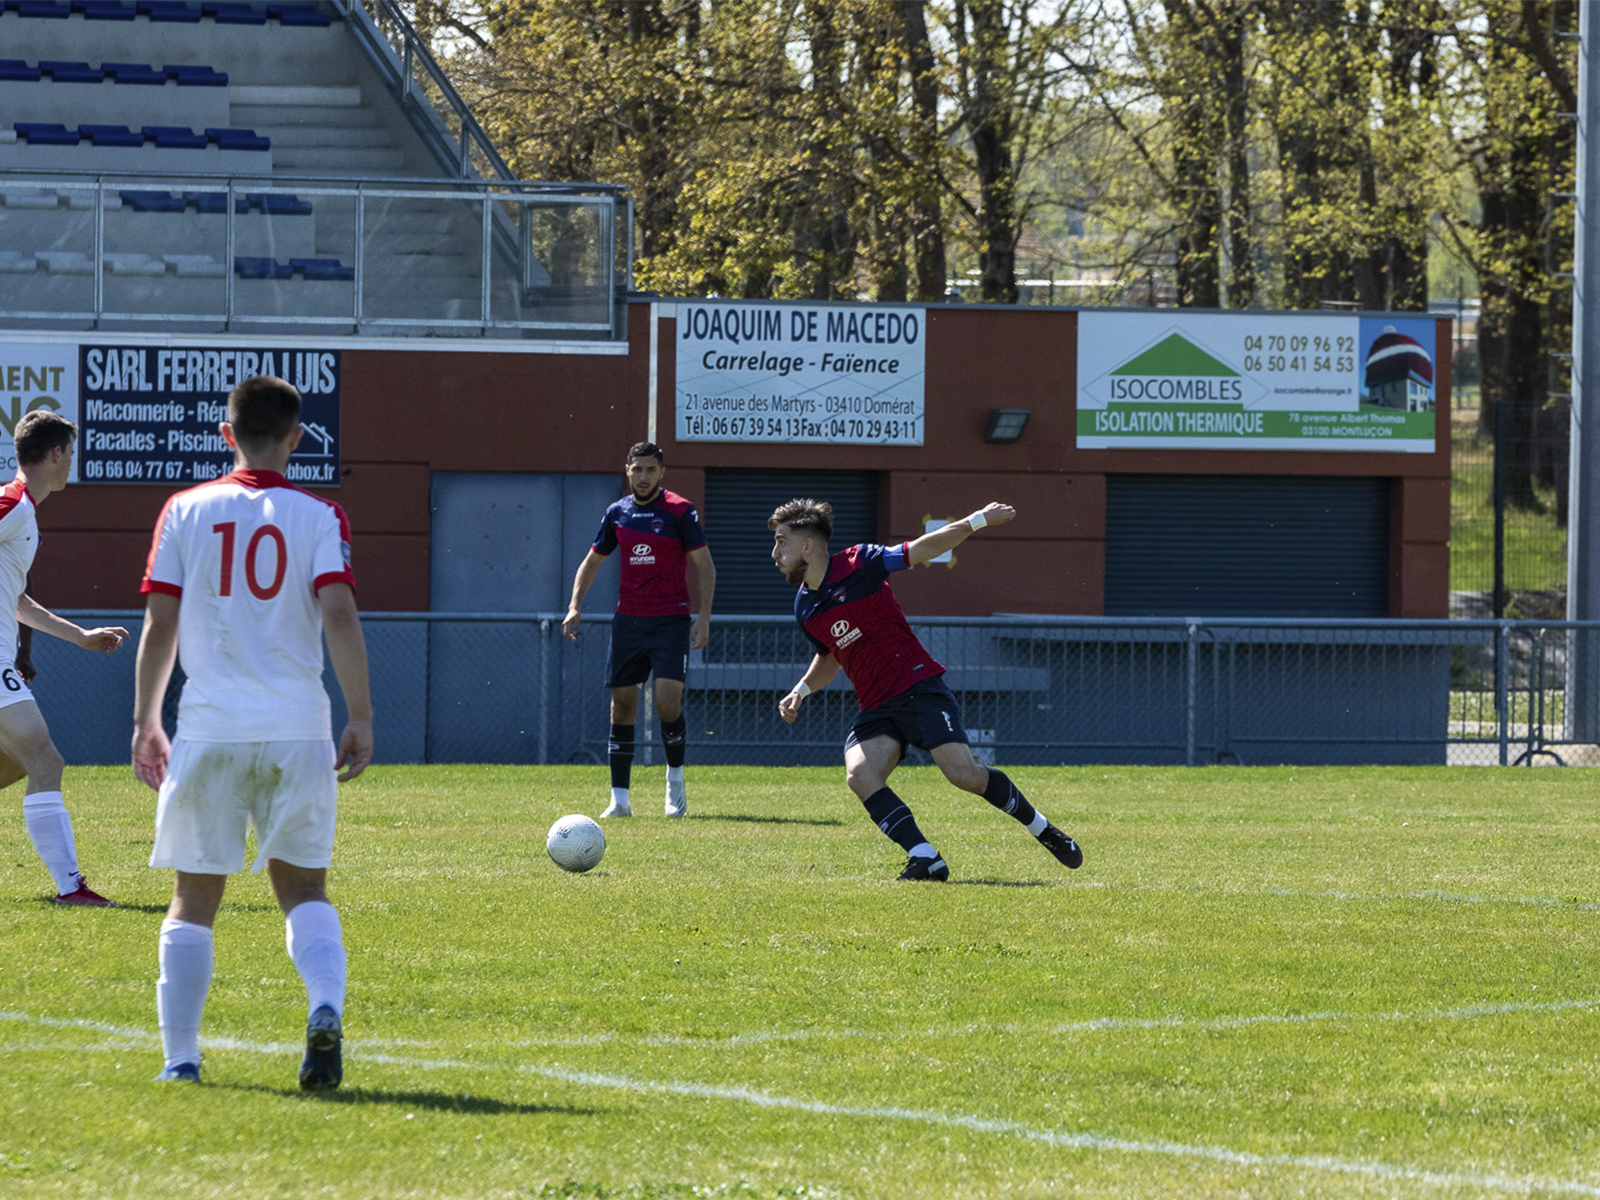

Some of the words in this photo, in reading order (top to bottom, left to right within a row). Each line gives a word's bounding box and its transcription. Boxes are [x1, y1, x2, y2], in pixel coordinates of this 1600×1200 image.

[682, 308, 782, 345] JOAQUIM
[791, 311, 817, 342] DE
[826, 311, 918, 345] MACEDO
[1244, 335, 1263, 351] 04
[1268, 336, 1286, 351] 70
[1290, 336, 1308, 351] 09
[1313, 336, 1331, 352] 96
[1336, 337, 1354, 352] 92
[86, 348, 153, 391] SARL
[157, 350, 275, 392] FERREIRA
[282, 351, 336, 394] LUIS
[702, 350, 804, 376] Carrelage
[820, 352, 899, 374] Faïence
[1244, 356, 1263, 371] 06
[1268, 356, 1286, 371] 50
[1290, 356, 1307, 371] 41
[1313, 356, 1331, 372] 54
[1336, 356, 1354, 372] 53
[0, 366, 65, 392] ENT
[1110, 378, 1243, 401] ISOCOMBLES
[86, 399, 185, 422] Maconnerie
[685, 393, 698, 410] 21
[702, 397, 745, 411] avenue
[748, 393, 769, 412] des
[771, 394, 816, 417] Martyrs
[825, 396, 861, 413] 03410
[864, 396, 915, 415] Domérat
[712, 416, 728, 435] 06
[730, 417, 746, 436] 67
[749, 417, 765, 436] 39
[767, 418, 782, 436] 54
[830, 419, 846, 438] 04
[849, 419, 864, 438] 70
[866, 420, 881, 438] 29
[884, 420, 899, 439] 43
[903, 420, 916, 439] 11
[1095, 411, 1174, 432] ISOLATION
[1176, 413, 1264, 434] THERMIQUE
[1302, 414, 1338, 423] avenue
[1340, 413, 1368, 423] Albert
[1370, 414, 1406, 424] Thomas
[86, 429, 156, 451] Facades
[167, 430, 236, 452] Piscine
[1301, 426, 1330, 436] 03100
[1331, 426, 1393, 438] MONTLUÇON
[86, 460, 104, 479] 06
[105, 460, 123, 479] 66
[125, 460, 143, 479] 04
[145, 460, 164, 479] 77
[165, 461, 184, 479] 67
[212, 521, 288, 601] 10
[835, 627, 861, 647] HYUNDAI
[2, 668, 21, 692] 6
